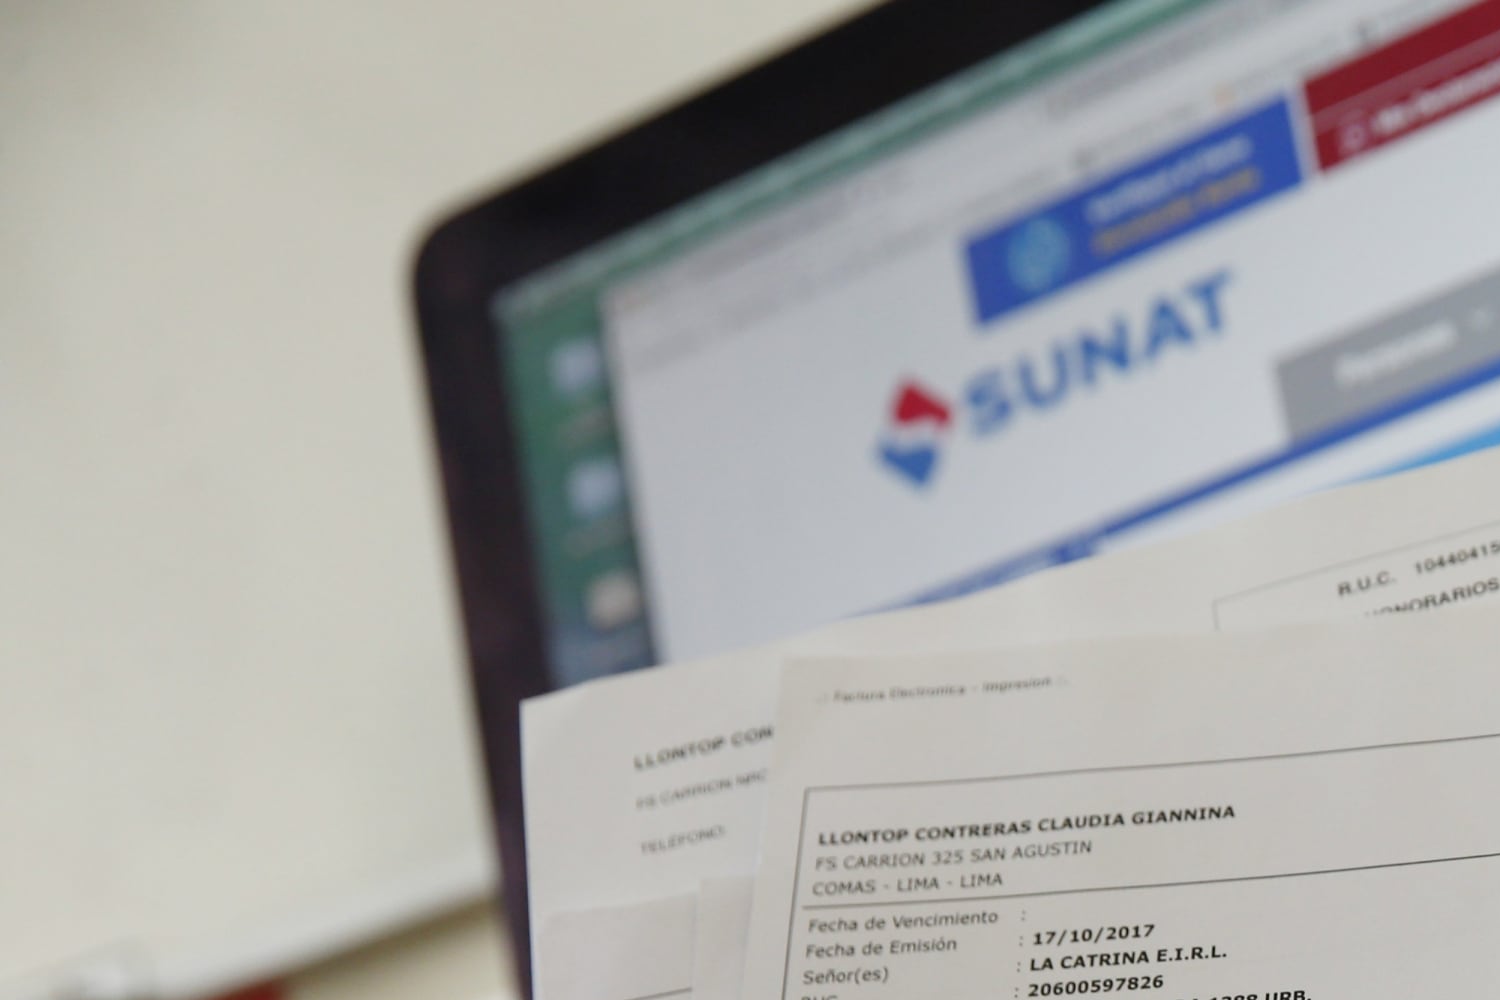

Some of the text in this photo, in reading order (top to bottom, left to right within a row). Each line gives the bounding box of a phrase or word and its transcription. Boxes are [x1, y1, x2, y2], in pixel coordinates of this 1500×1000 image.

[964, 269, 1233, 437] SUNAT
[818, 805, 1235, 847] LLONTOP CONTRERAS CLAUDIA GIANNINA
[843, 841, 1093, 870] CARRION 325 SAN AGUSTIN
[812, 873, 1003, 896] COMAS LIMA LIMA
[808, 909, 999, 933] Fecha de Vencimiento
[1032, 924, 1155, 945] 17/10/2017
[805, 937, 958, 958] Fecha de Emisión
[1030, 945, 1227, 971] LA CATRINA E.I.R.L.
[802, 967, 889, 986] Señor(es)
[1027, 975, 1164, 997] 20600597826
